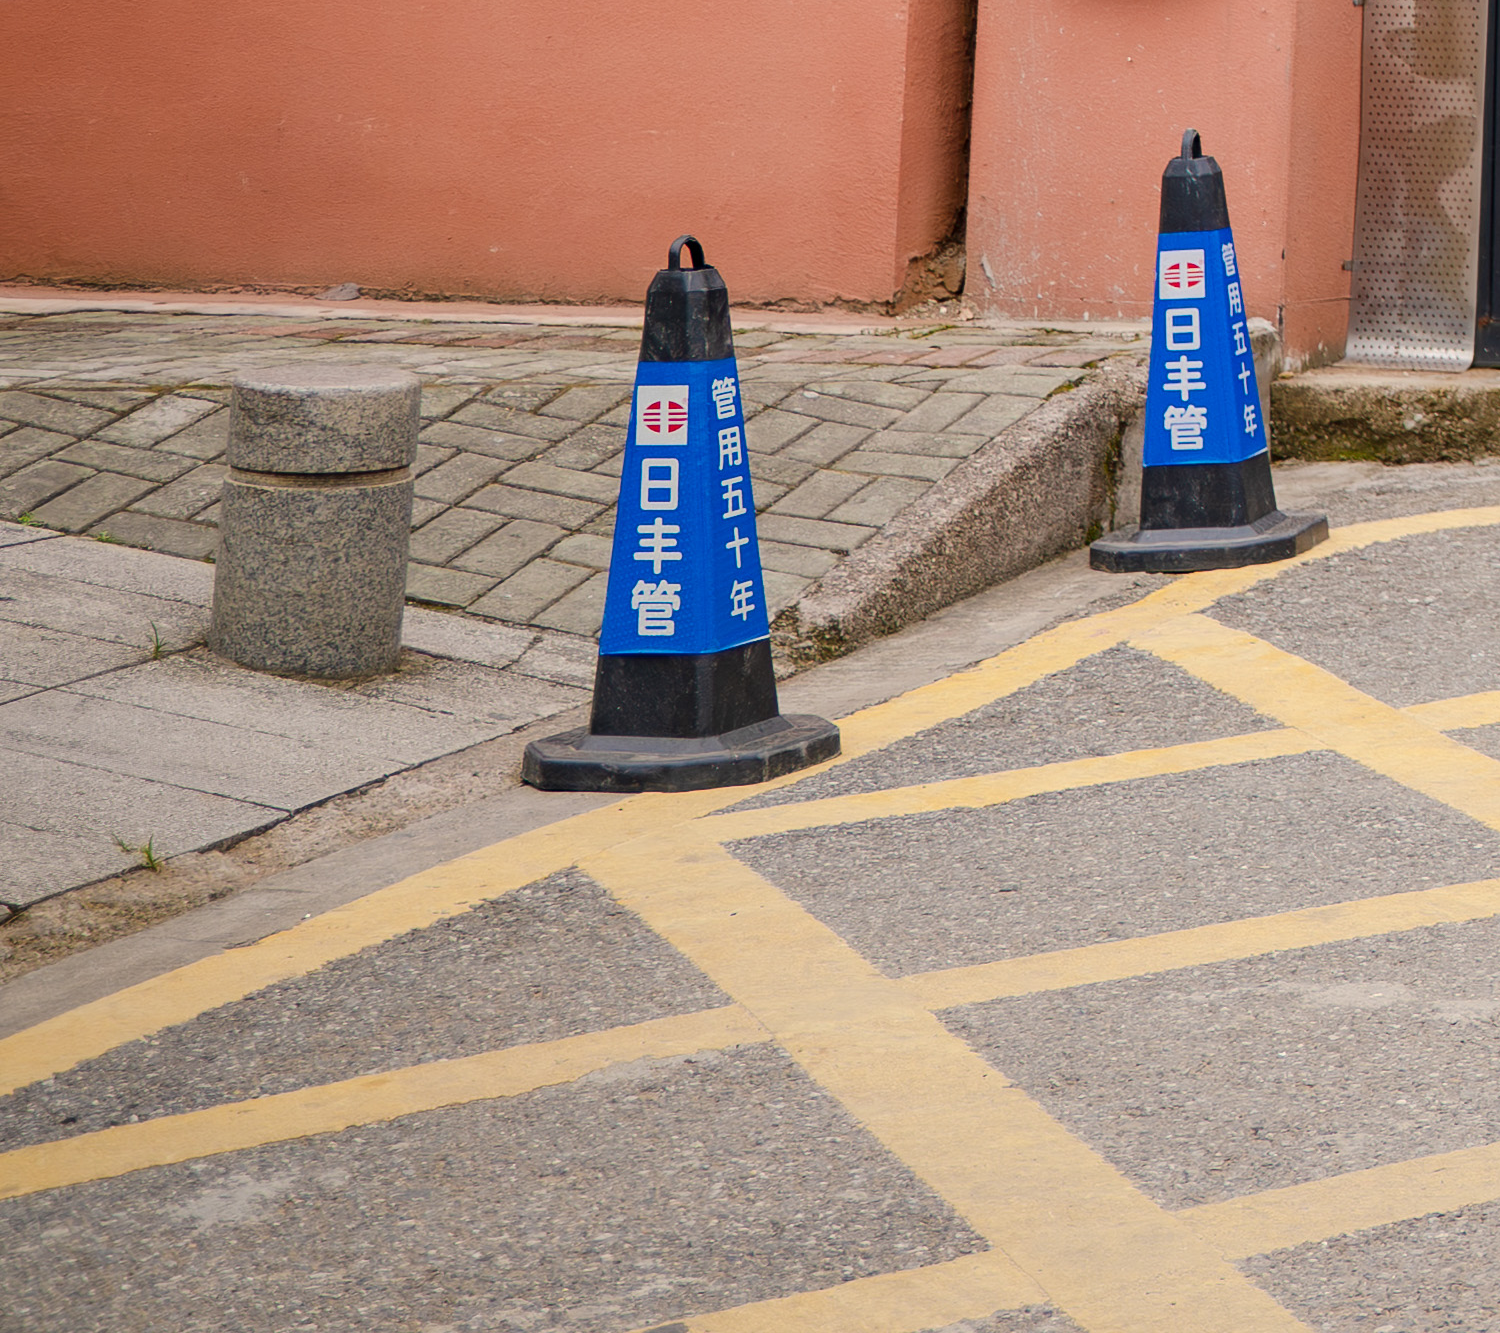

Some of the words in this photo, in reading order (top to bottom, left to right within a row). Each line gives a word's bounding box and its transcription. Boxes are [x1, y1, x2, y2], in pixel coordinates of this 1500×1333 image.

[1164, 306, 1207, 451] 日丰管
[1221, 241, 1258, 439] 管用五十年
[630, 456, 683, 637] 日丰管
[711, 375, 756, 622] 管用五十年
